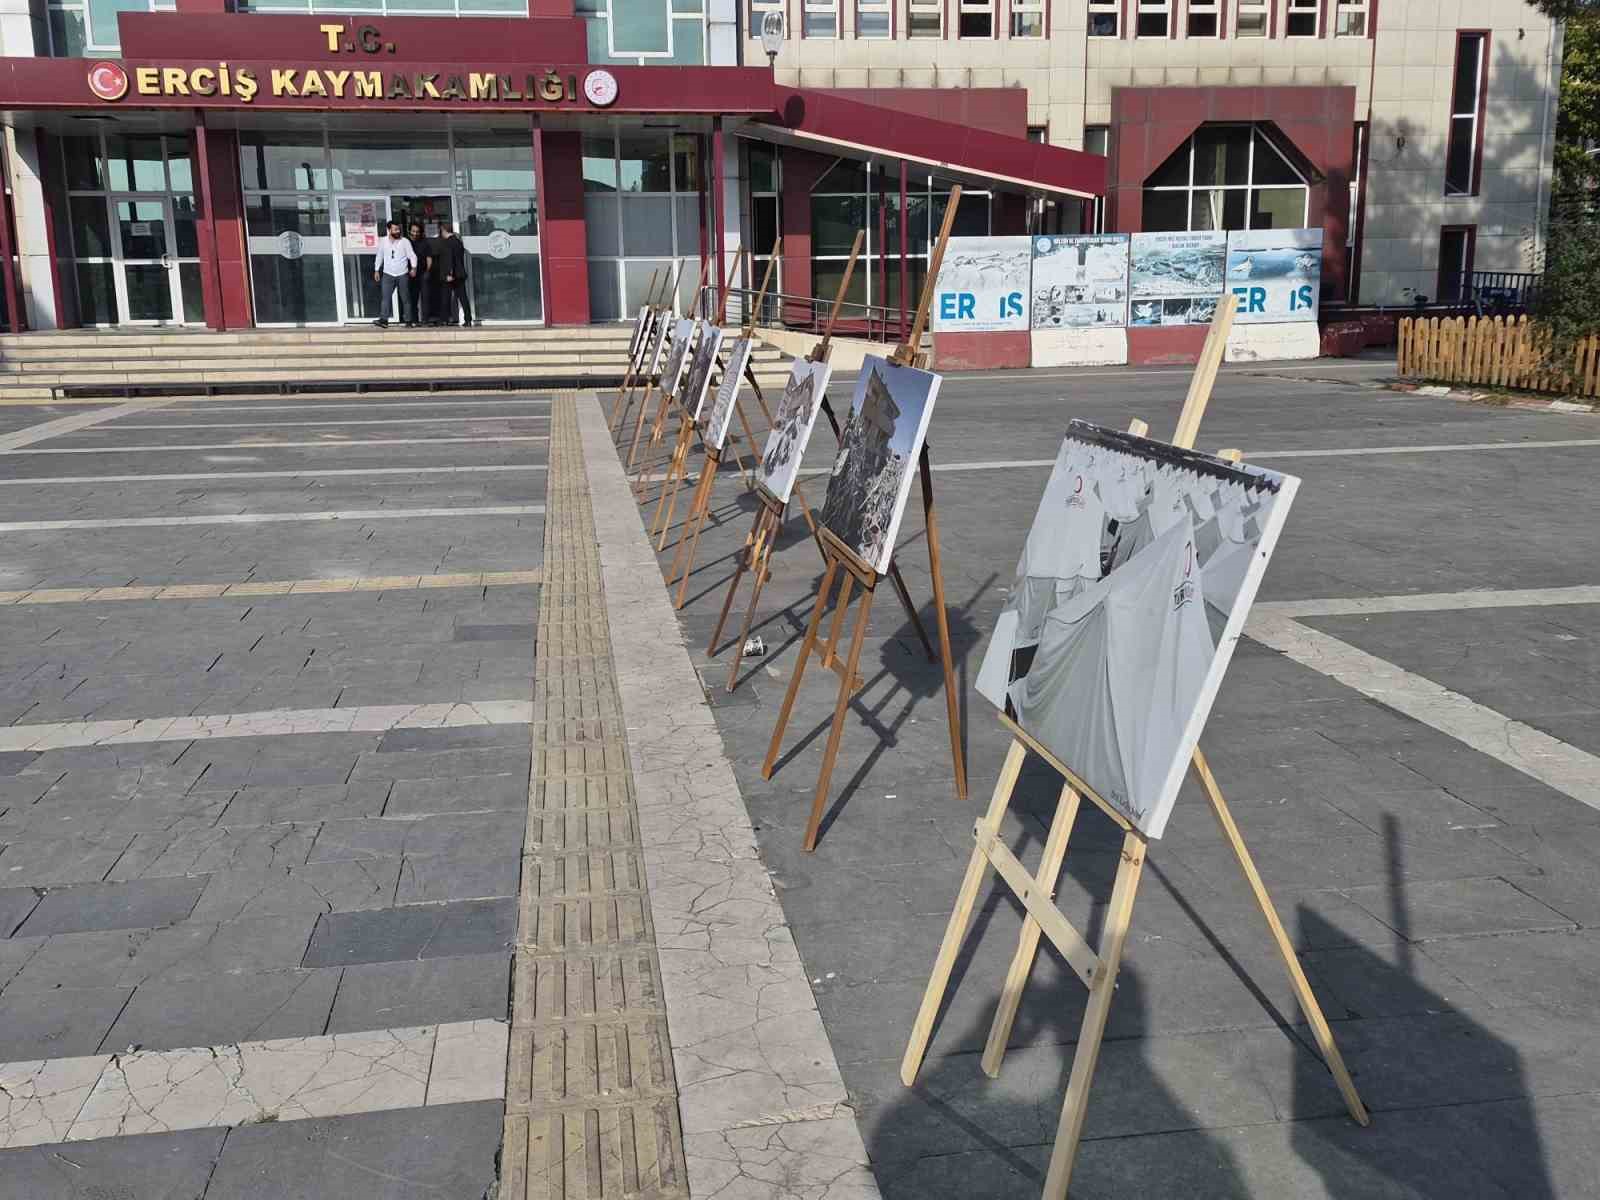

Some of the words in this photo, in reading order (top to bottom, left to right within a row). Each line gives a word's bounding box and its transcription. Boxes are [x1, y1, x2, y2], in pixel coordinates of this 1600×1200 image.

[320, 24, 395, 53] T.C.
[136, 62, 258, 102] ERCİŞ
[271, 67, 577, 101] KAYMAKAMLIĞI
